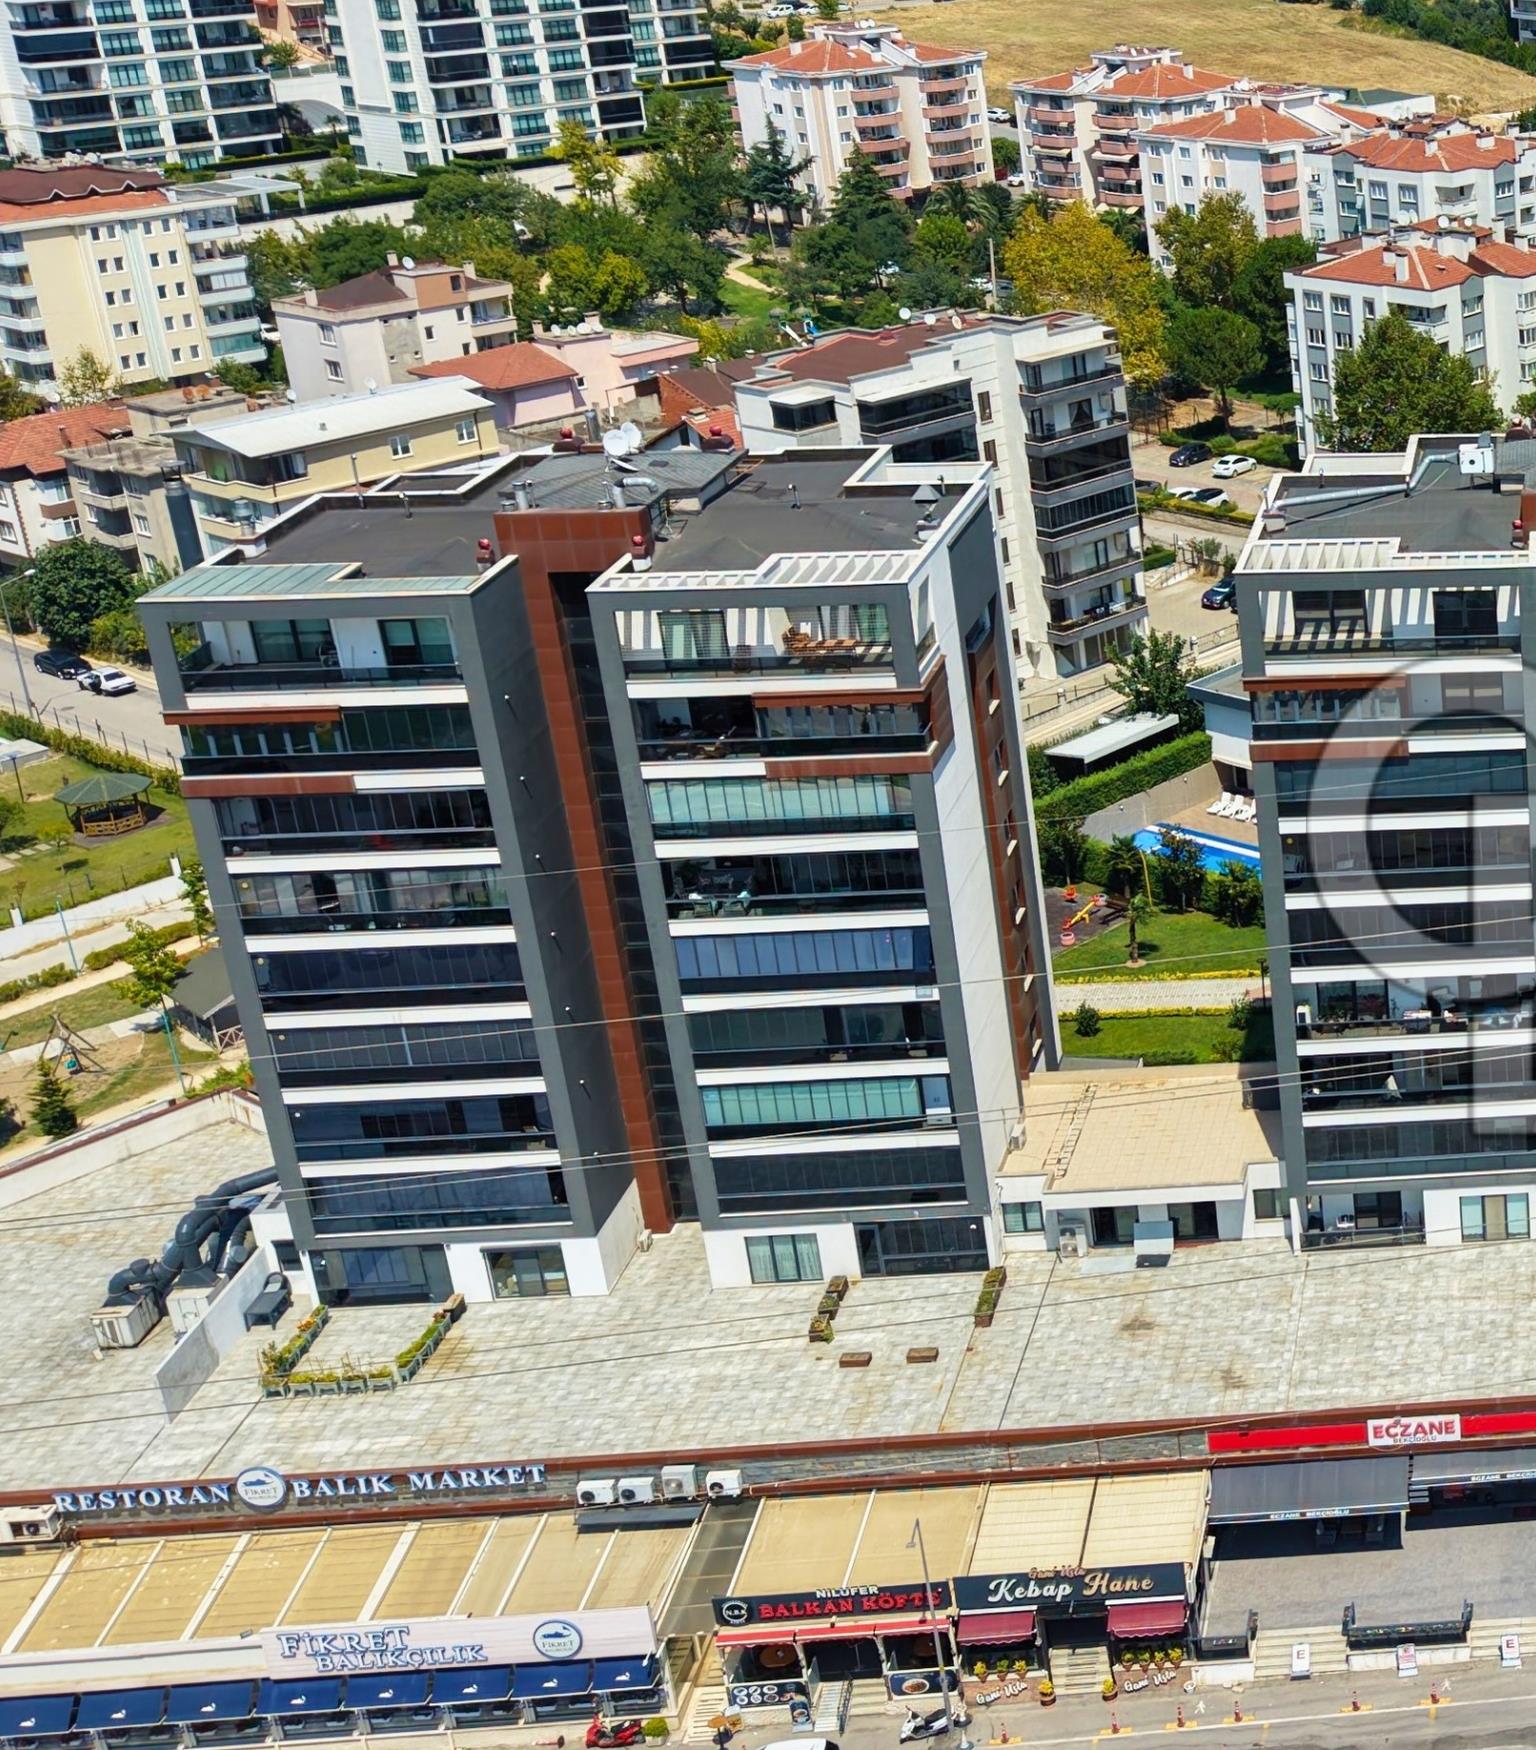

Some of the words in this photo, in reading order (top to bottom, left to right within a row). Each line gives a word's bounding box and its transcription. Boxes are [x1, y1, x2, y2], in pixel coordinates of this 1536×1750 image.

[1372, 1419, 1456, 1439] ECZANE
[52, 1483, 232, 1513] RESTORAN
[290, 1472, 396, 1498] BALIK
[406, 1464, 547, 1492] MARKET
[987, 1577, 1074, 1602] Kebap
[1082, 1571, 1155, 1597] Hane
[757, 1597, 854, 1621] BALKAN
[277, 1625, 410, 1659] FİKRET
[1296, 1650, 1306, 1660] E
[1505, 1638, 1516, 1649] E
[314, 1644, 488, 1673] BALIKÇILIK
